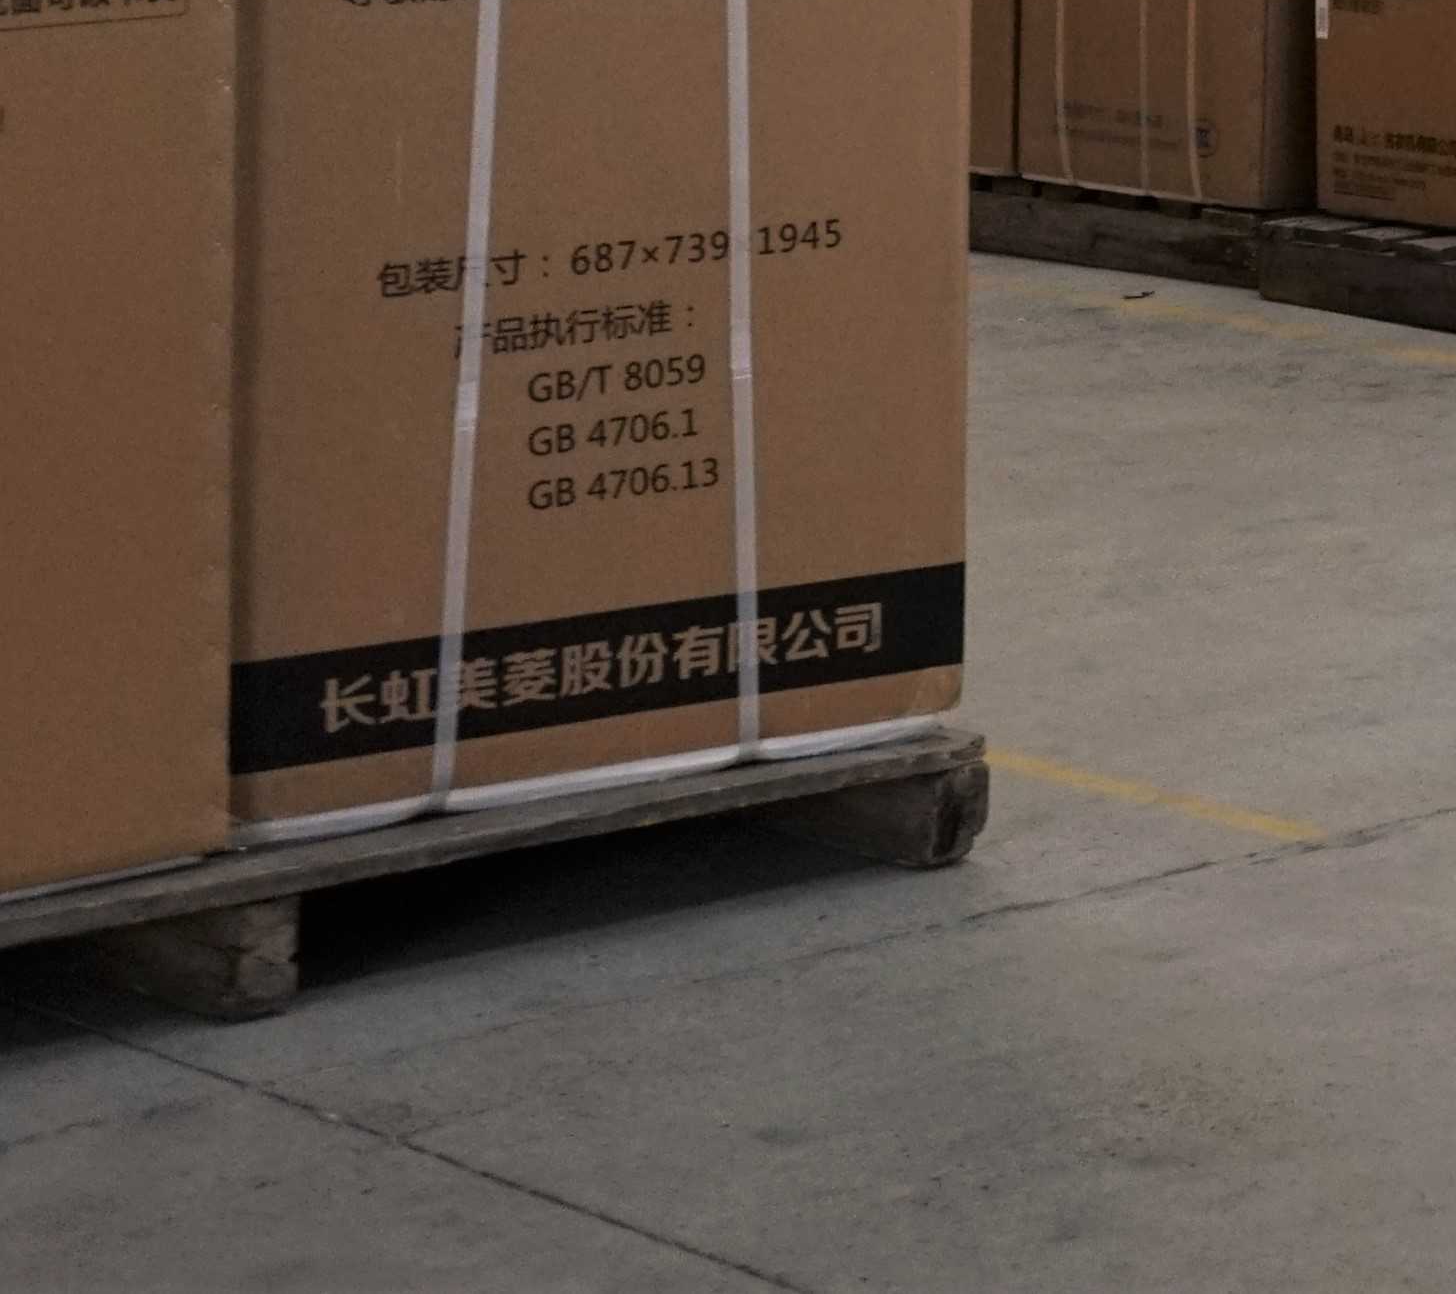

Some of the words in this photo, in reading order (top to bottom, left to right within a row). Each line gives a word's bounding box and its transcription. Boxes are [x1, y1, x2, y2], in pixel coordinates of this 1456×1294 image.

[527, 365, 611, 404] GB/T
[623, 354, 706, 393] 8059
[528, 424, 575, 457] GB
[587, 409, 698, 449] 4706.1
[528, 479, 576, 511] GB
[587, 458, 720, 502] 4706.13
[319, 602, 884, 735] 长虹美菱股份有限公司
